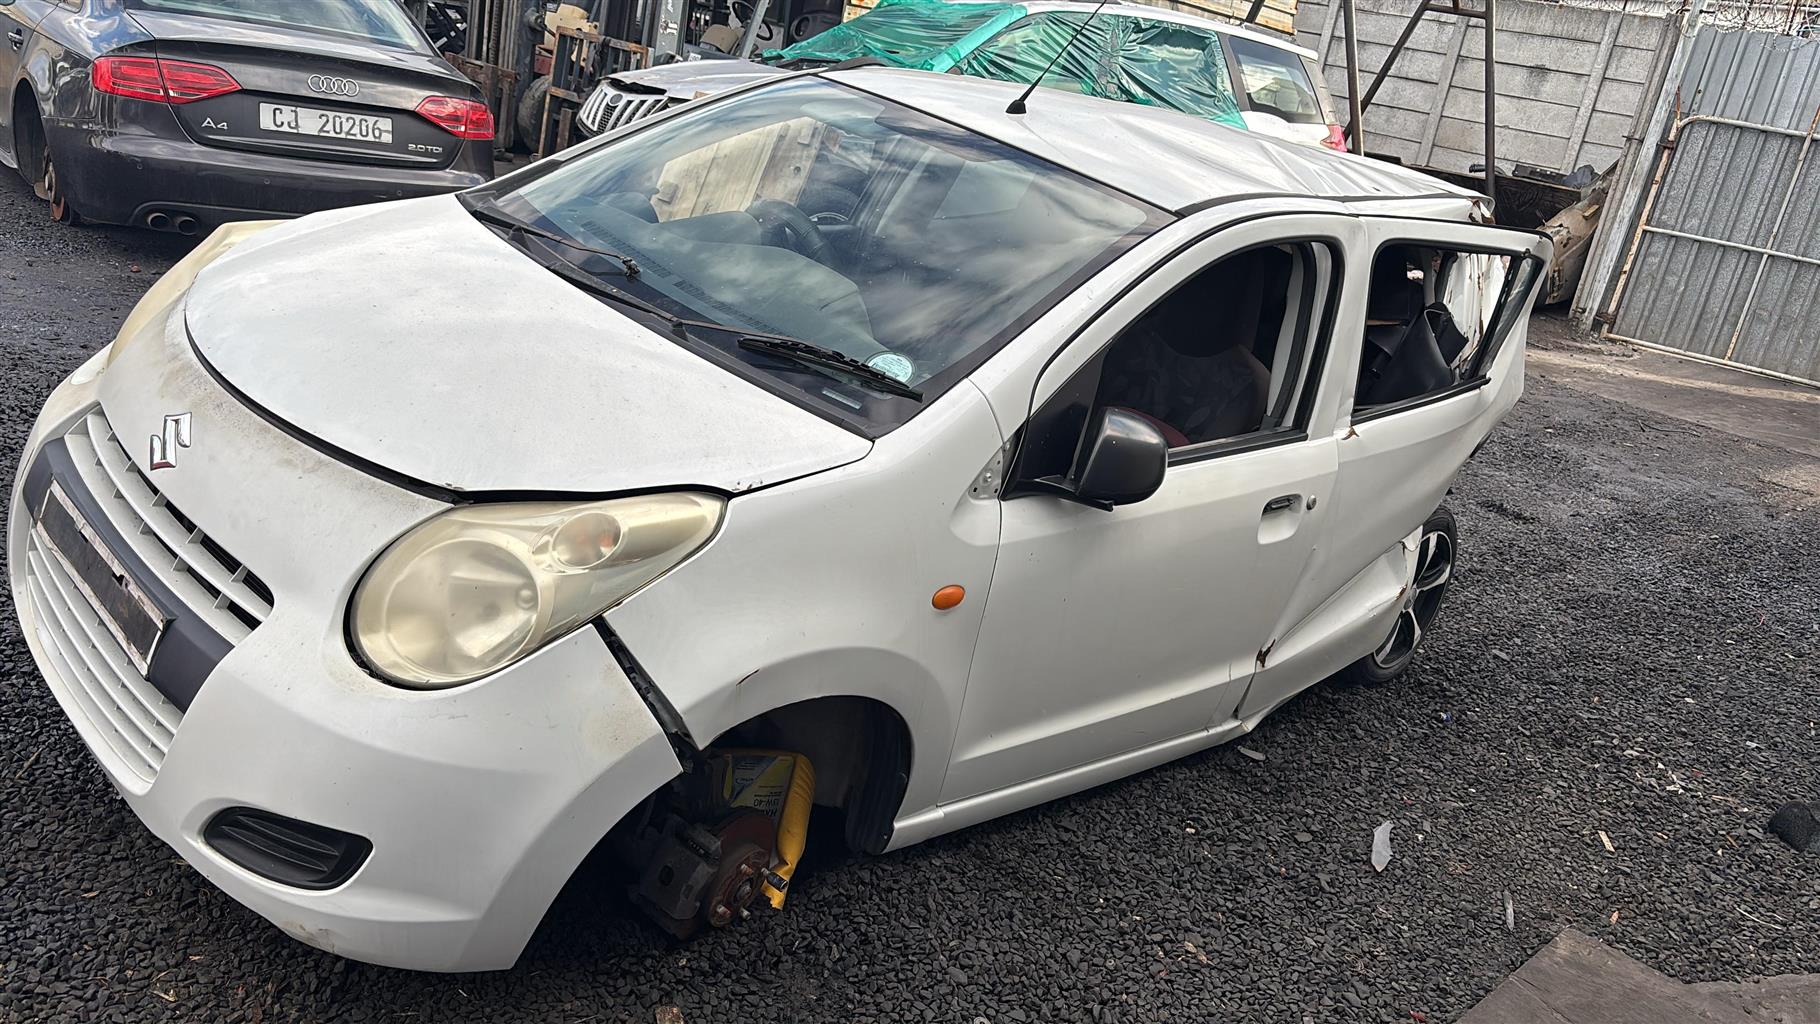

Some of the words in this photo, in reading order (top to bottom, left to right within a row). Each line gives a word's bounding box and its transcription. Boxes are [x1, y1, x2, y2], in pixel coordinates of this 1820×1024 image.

[201, 117, 228, 129] A4
[272, 107, 299, 131] CJ
[317, 113, 382, 140] 20206
